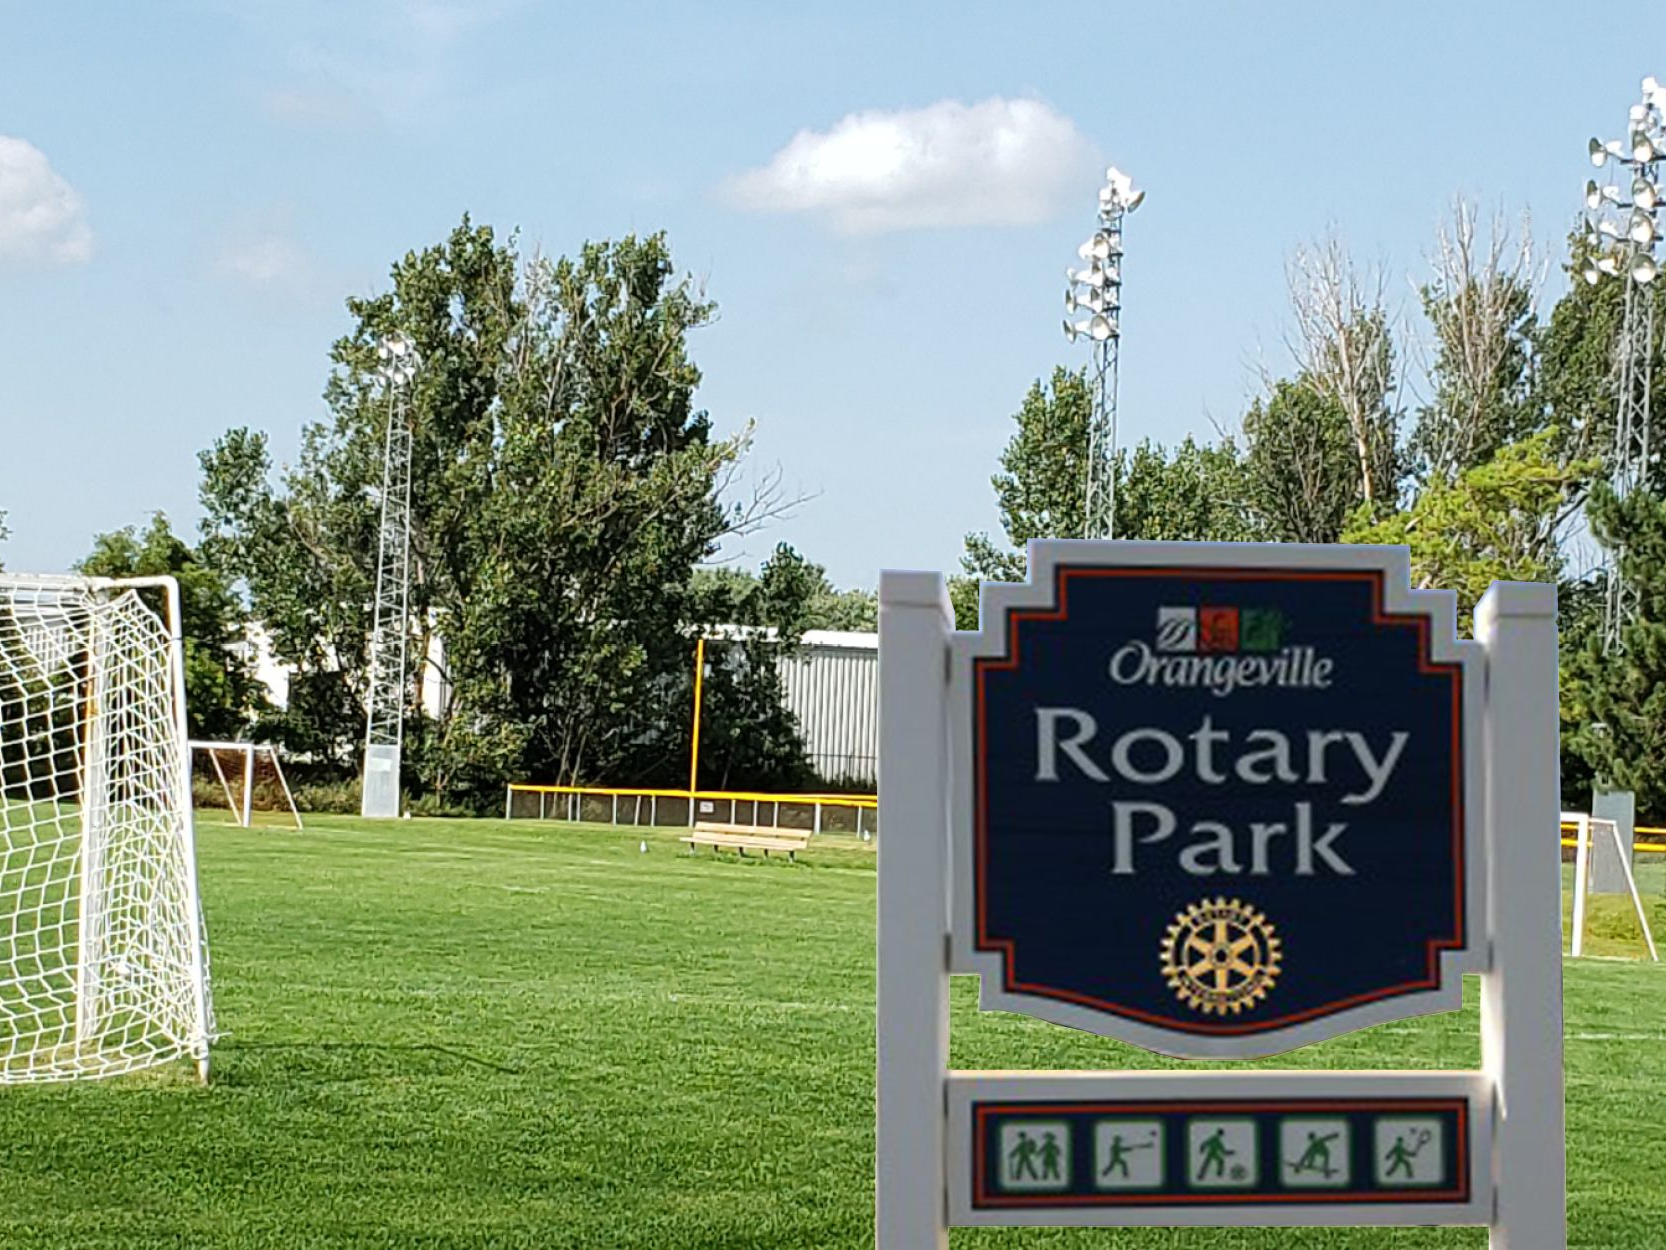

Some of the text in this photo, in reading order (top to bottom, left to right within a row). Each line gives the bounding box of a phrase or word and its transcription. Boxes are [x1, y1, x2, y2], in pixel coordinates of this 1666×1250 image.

[1110, 640, 1332, 696] Orangeville
[1035, 708, 1409, 803] Rotary
[1111, 802, 1356, 875] Park
